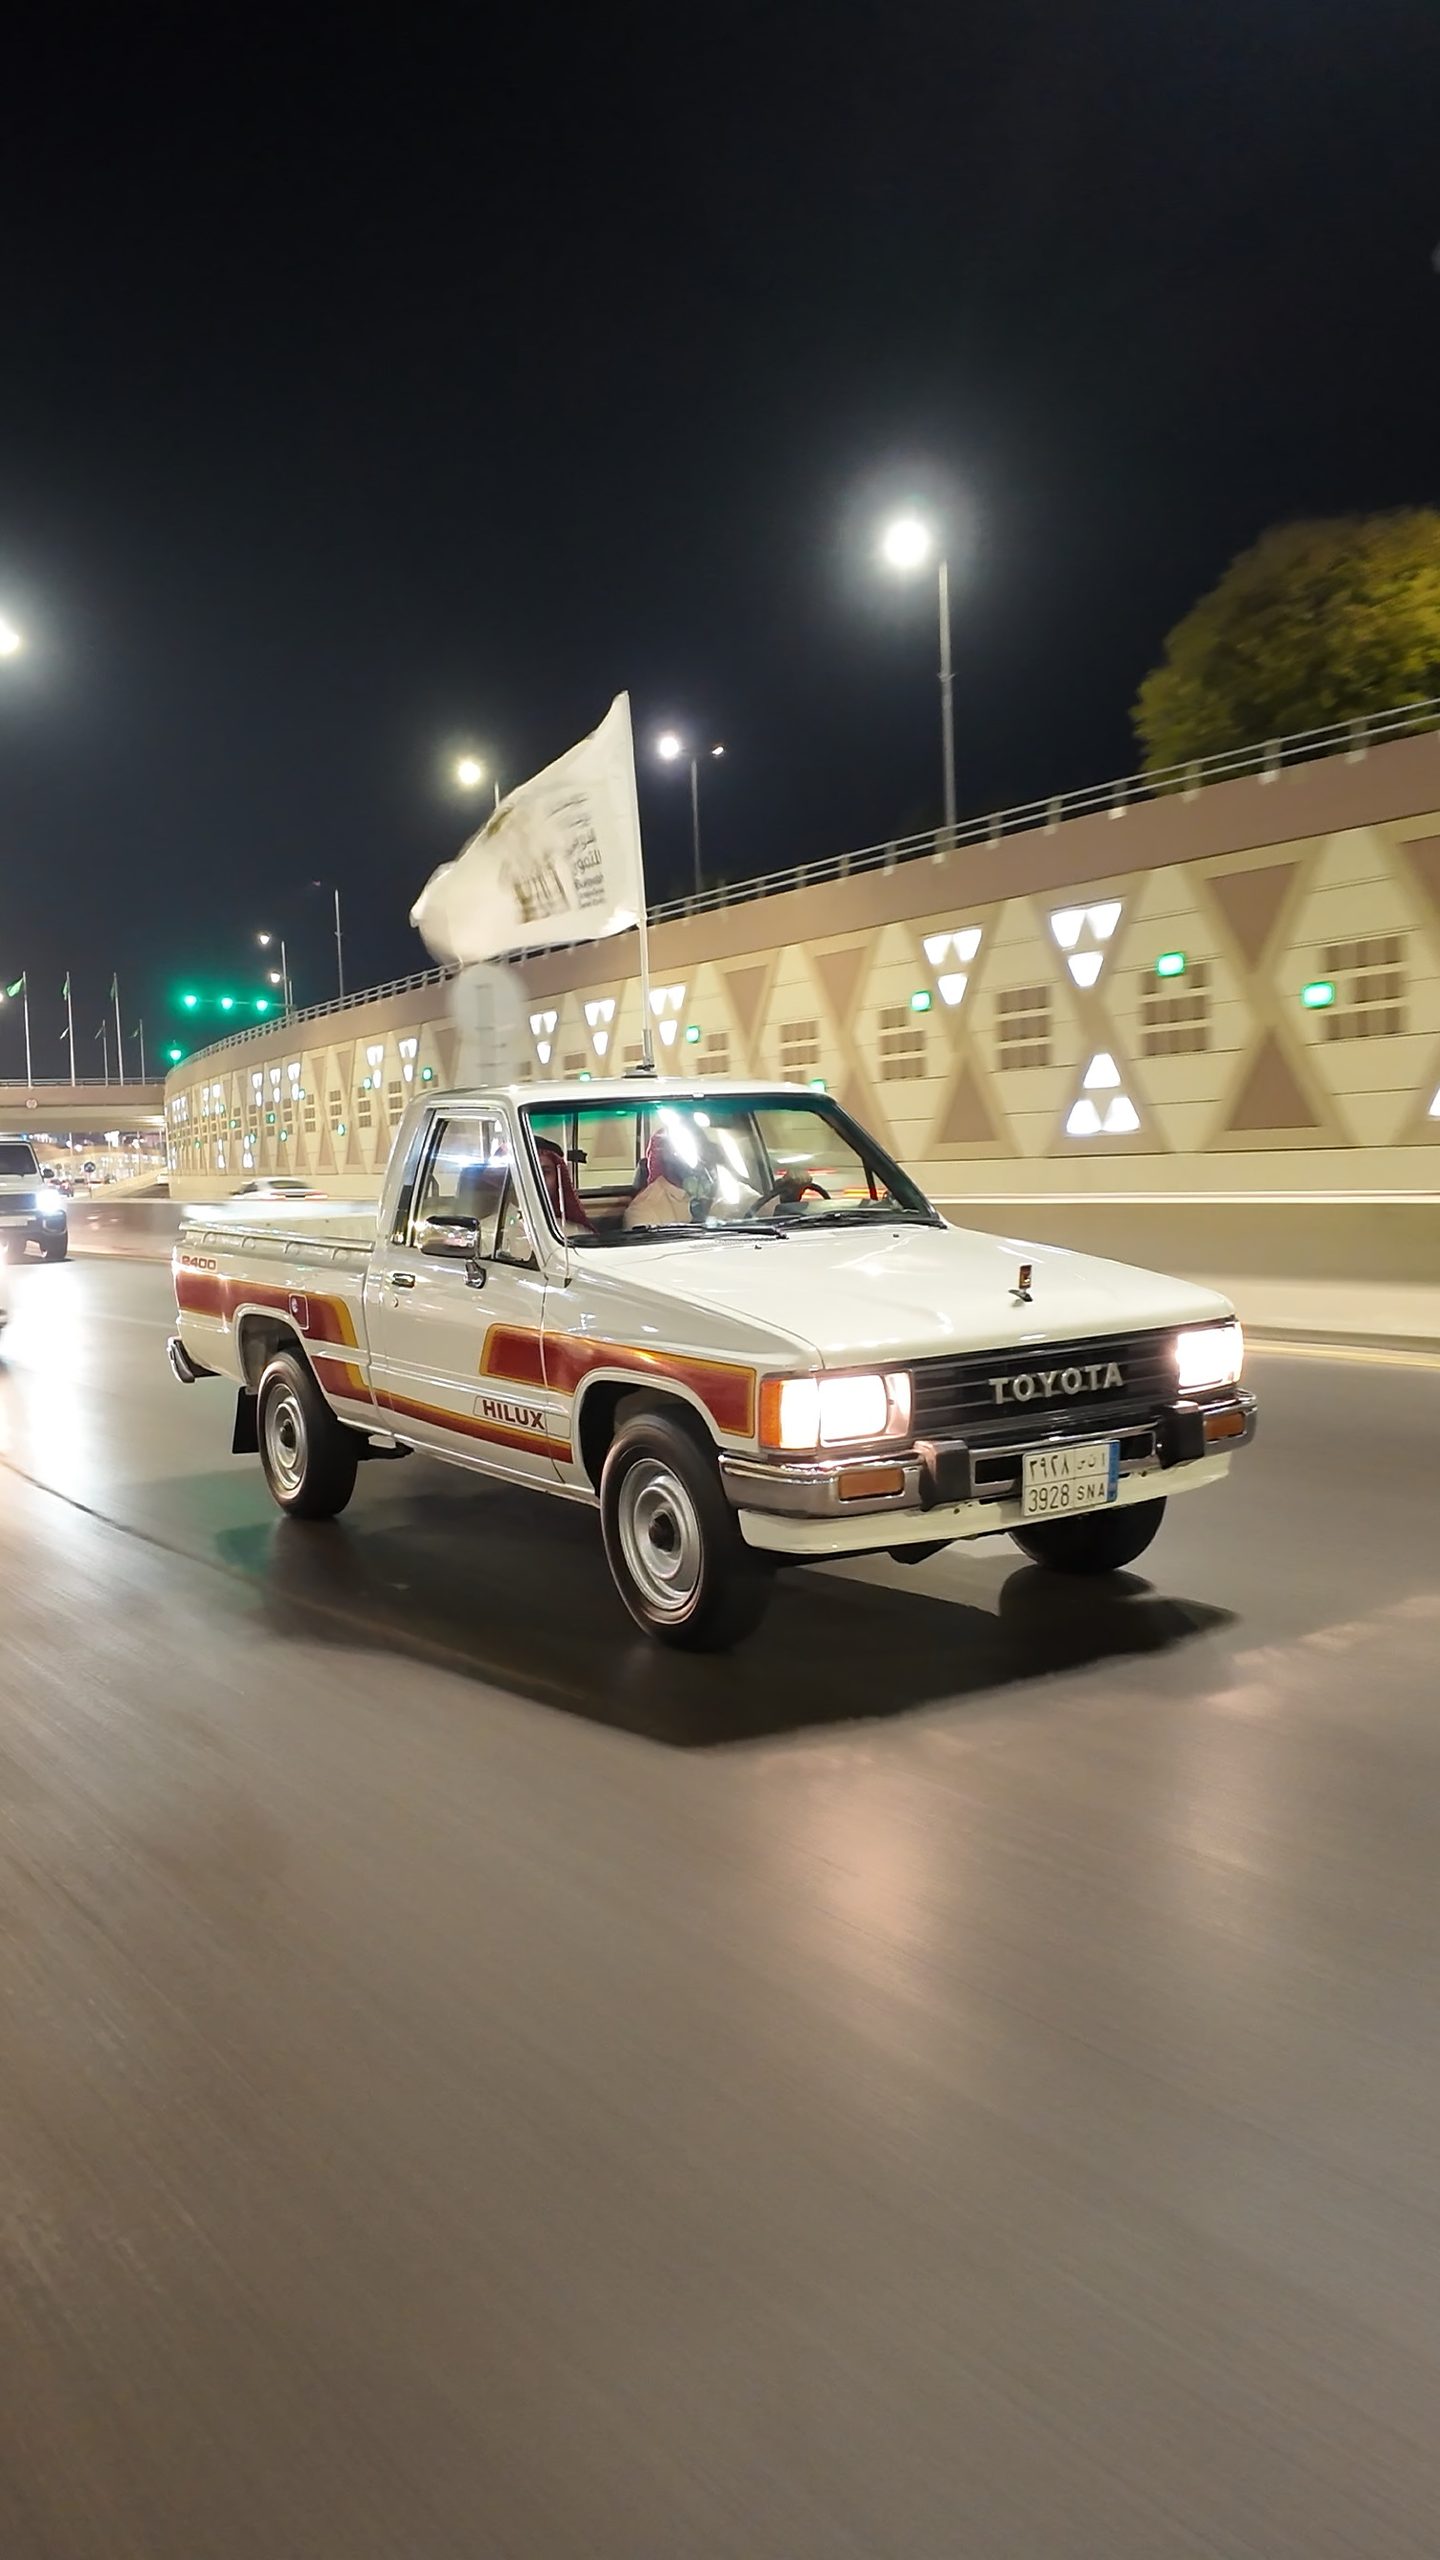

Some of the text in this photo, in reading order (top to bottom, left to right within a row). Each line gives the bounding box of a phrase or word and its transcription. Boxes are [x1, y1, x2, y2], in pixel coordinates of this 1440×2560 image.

[988, 1362, 1124, 1404] TOYOTA
[482, 1399, 545, 1430] HILUX
[1028, 1483, 1070, 1513] 3928
[1077, 1482, 1105, 1501] SNA
